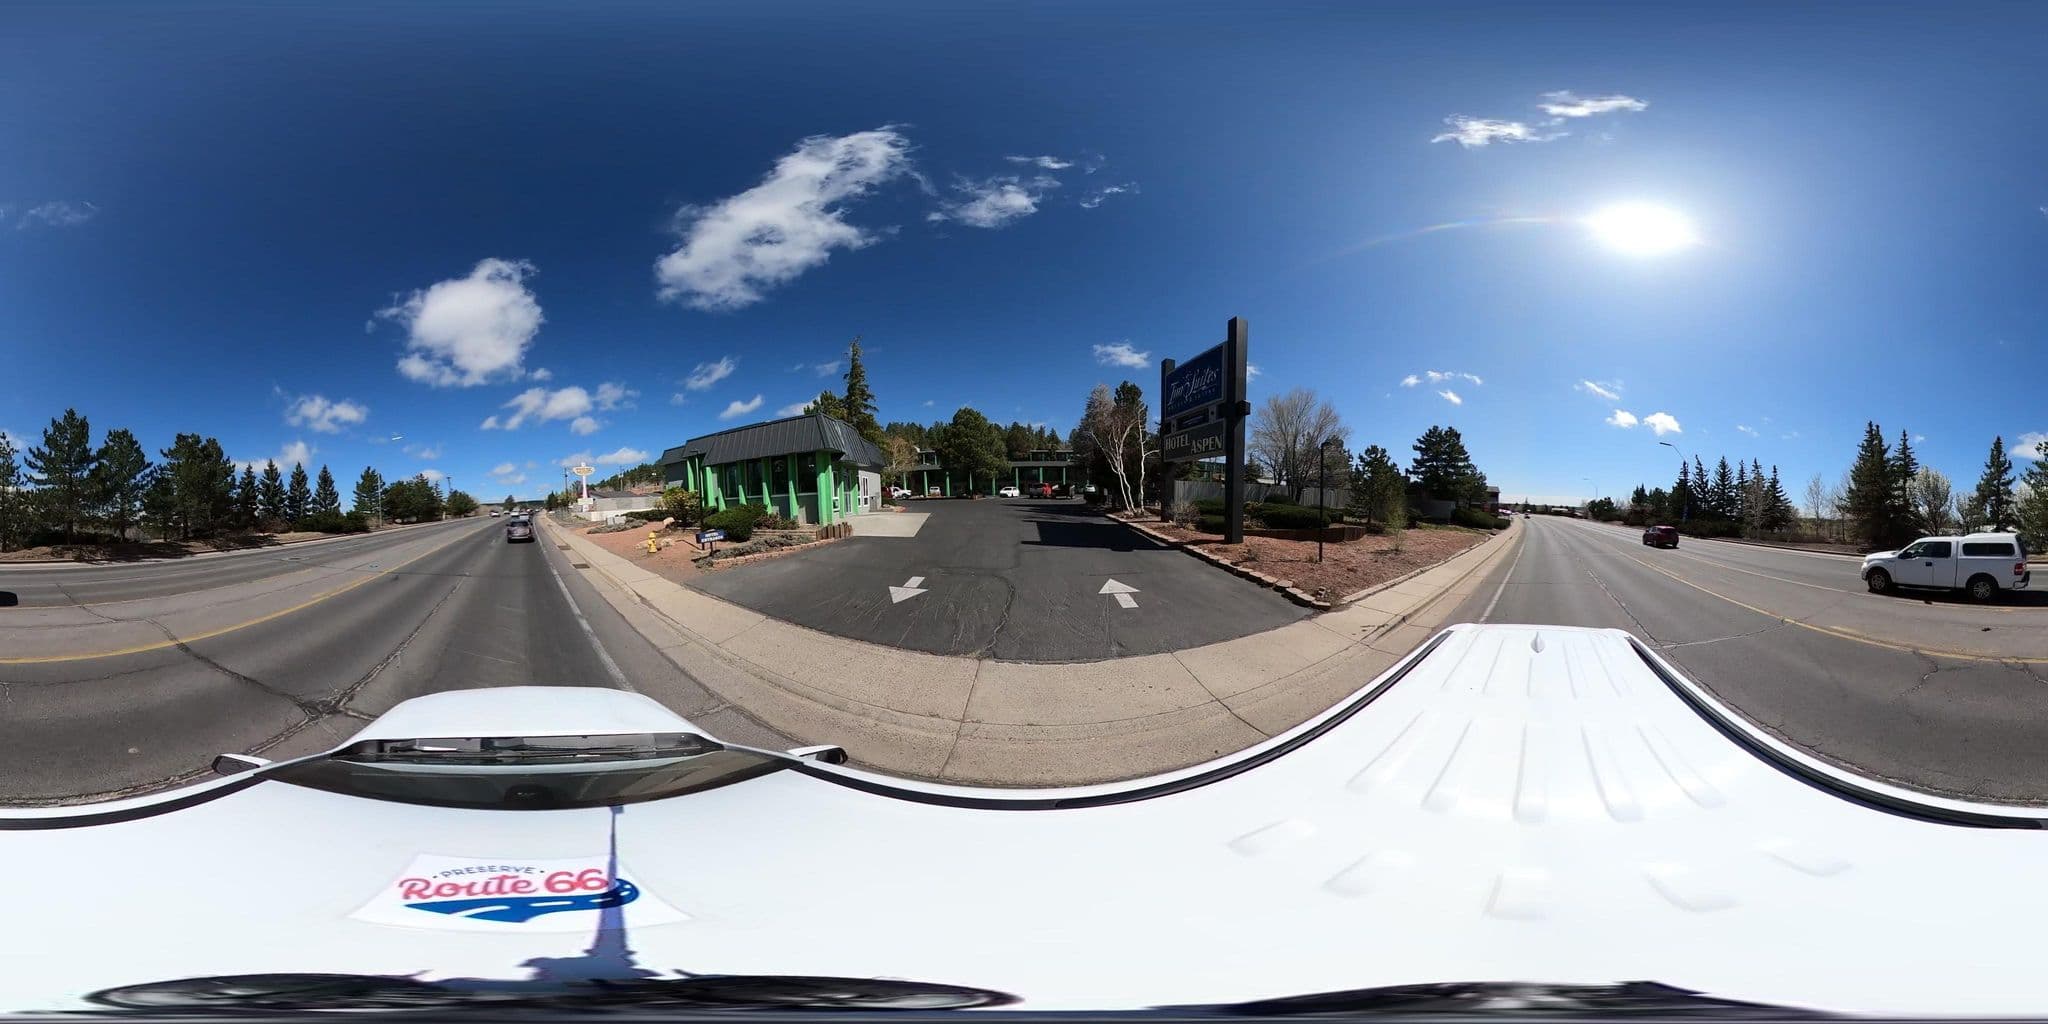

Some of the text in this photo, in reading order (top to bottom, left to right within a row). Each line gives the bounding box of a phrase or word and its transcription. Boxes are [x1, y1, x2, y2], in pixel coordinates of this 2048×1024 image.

[1165, 432, 1223, 454] HOTEL ASPEN
[440, 864, 536, 878] PRESERVE
[398, 868, 610, 900] Route 66
